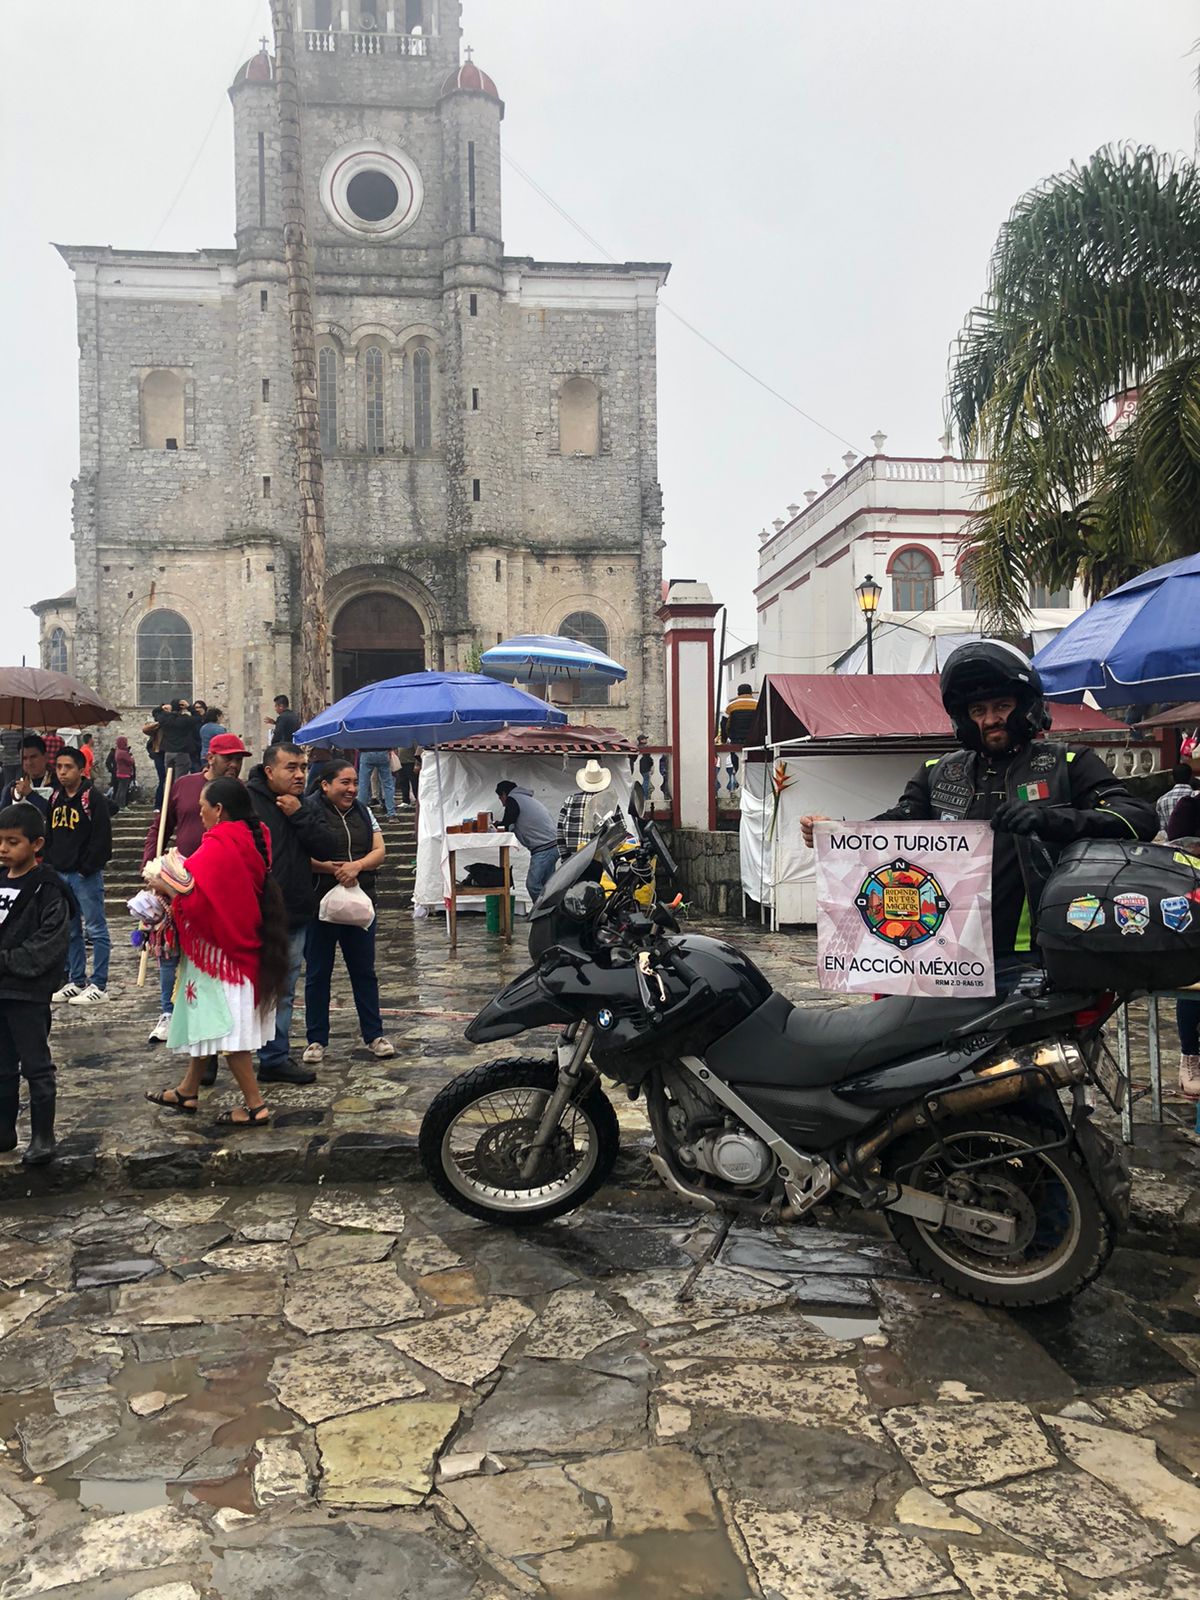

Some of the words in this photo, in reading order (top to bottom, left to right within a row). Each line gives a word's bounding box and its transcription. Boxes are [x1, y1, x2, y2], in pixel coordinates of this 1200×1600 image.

[52, 806, 80, 829] GAP
[831, 835, 888, 851] MOTO
[894, 835, 969, 851] TURISTA
[825, 956, 845, 970] EN
[849, 955, 915, 974] ACCIÓN
[919, 958, 985, 976] MÉXICO
